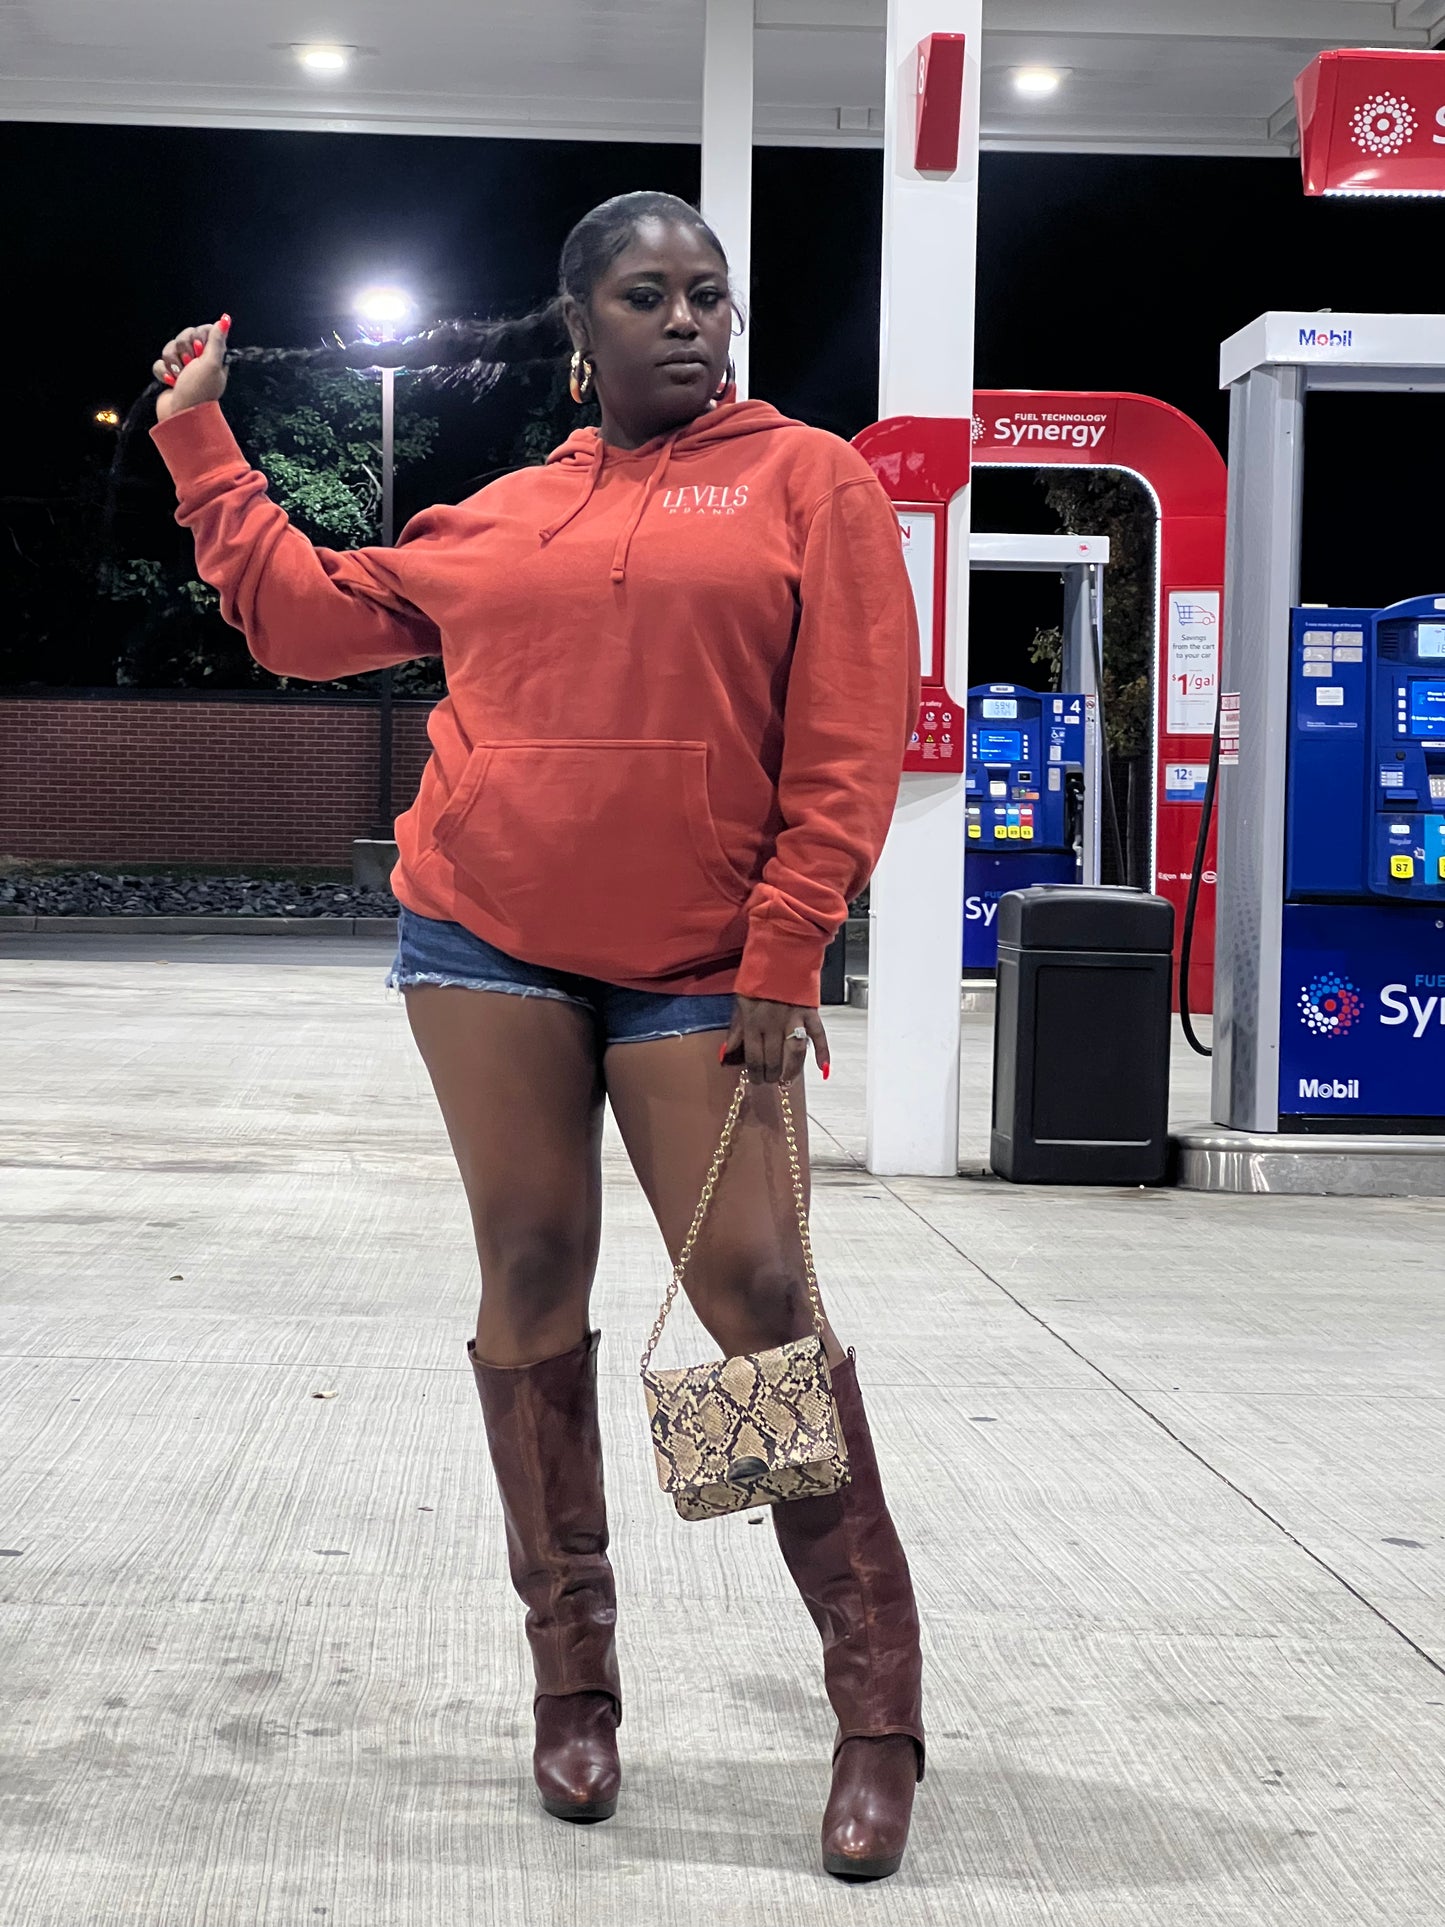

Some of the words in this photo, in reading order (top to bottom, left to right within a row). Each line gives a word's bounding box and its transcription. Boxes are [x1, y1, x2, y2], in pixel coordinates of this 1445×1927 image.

[1298, 328, 1352, 347] Mobil
[1014, 412, 1039, 421] FUEL
[1041, 413, 1107, 422] TECHNOLOGY
[993, 417, 1106, 448] Synergy
[663, 484, 749, 508] LEVELS
[1181, 634, 1206, 642] Savings
[1069, 699, 1082, 714] 4
[1395, 863, 1409, 873] 87
[1379, 983, 1445, 1038] Sy
[1298, 1078, 1360, 1099] Mobil
